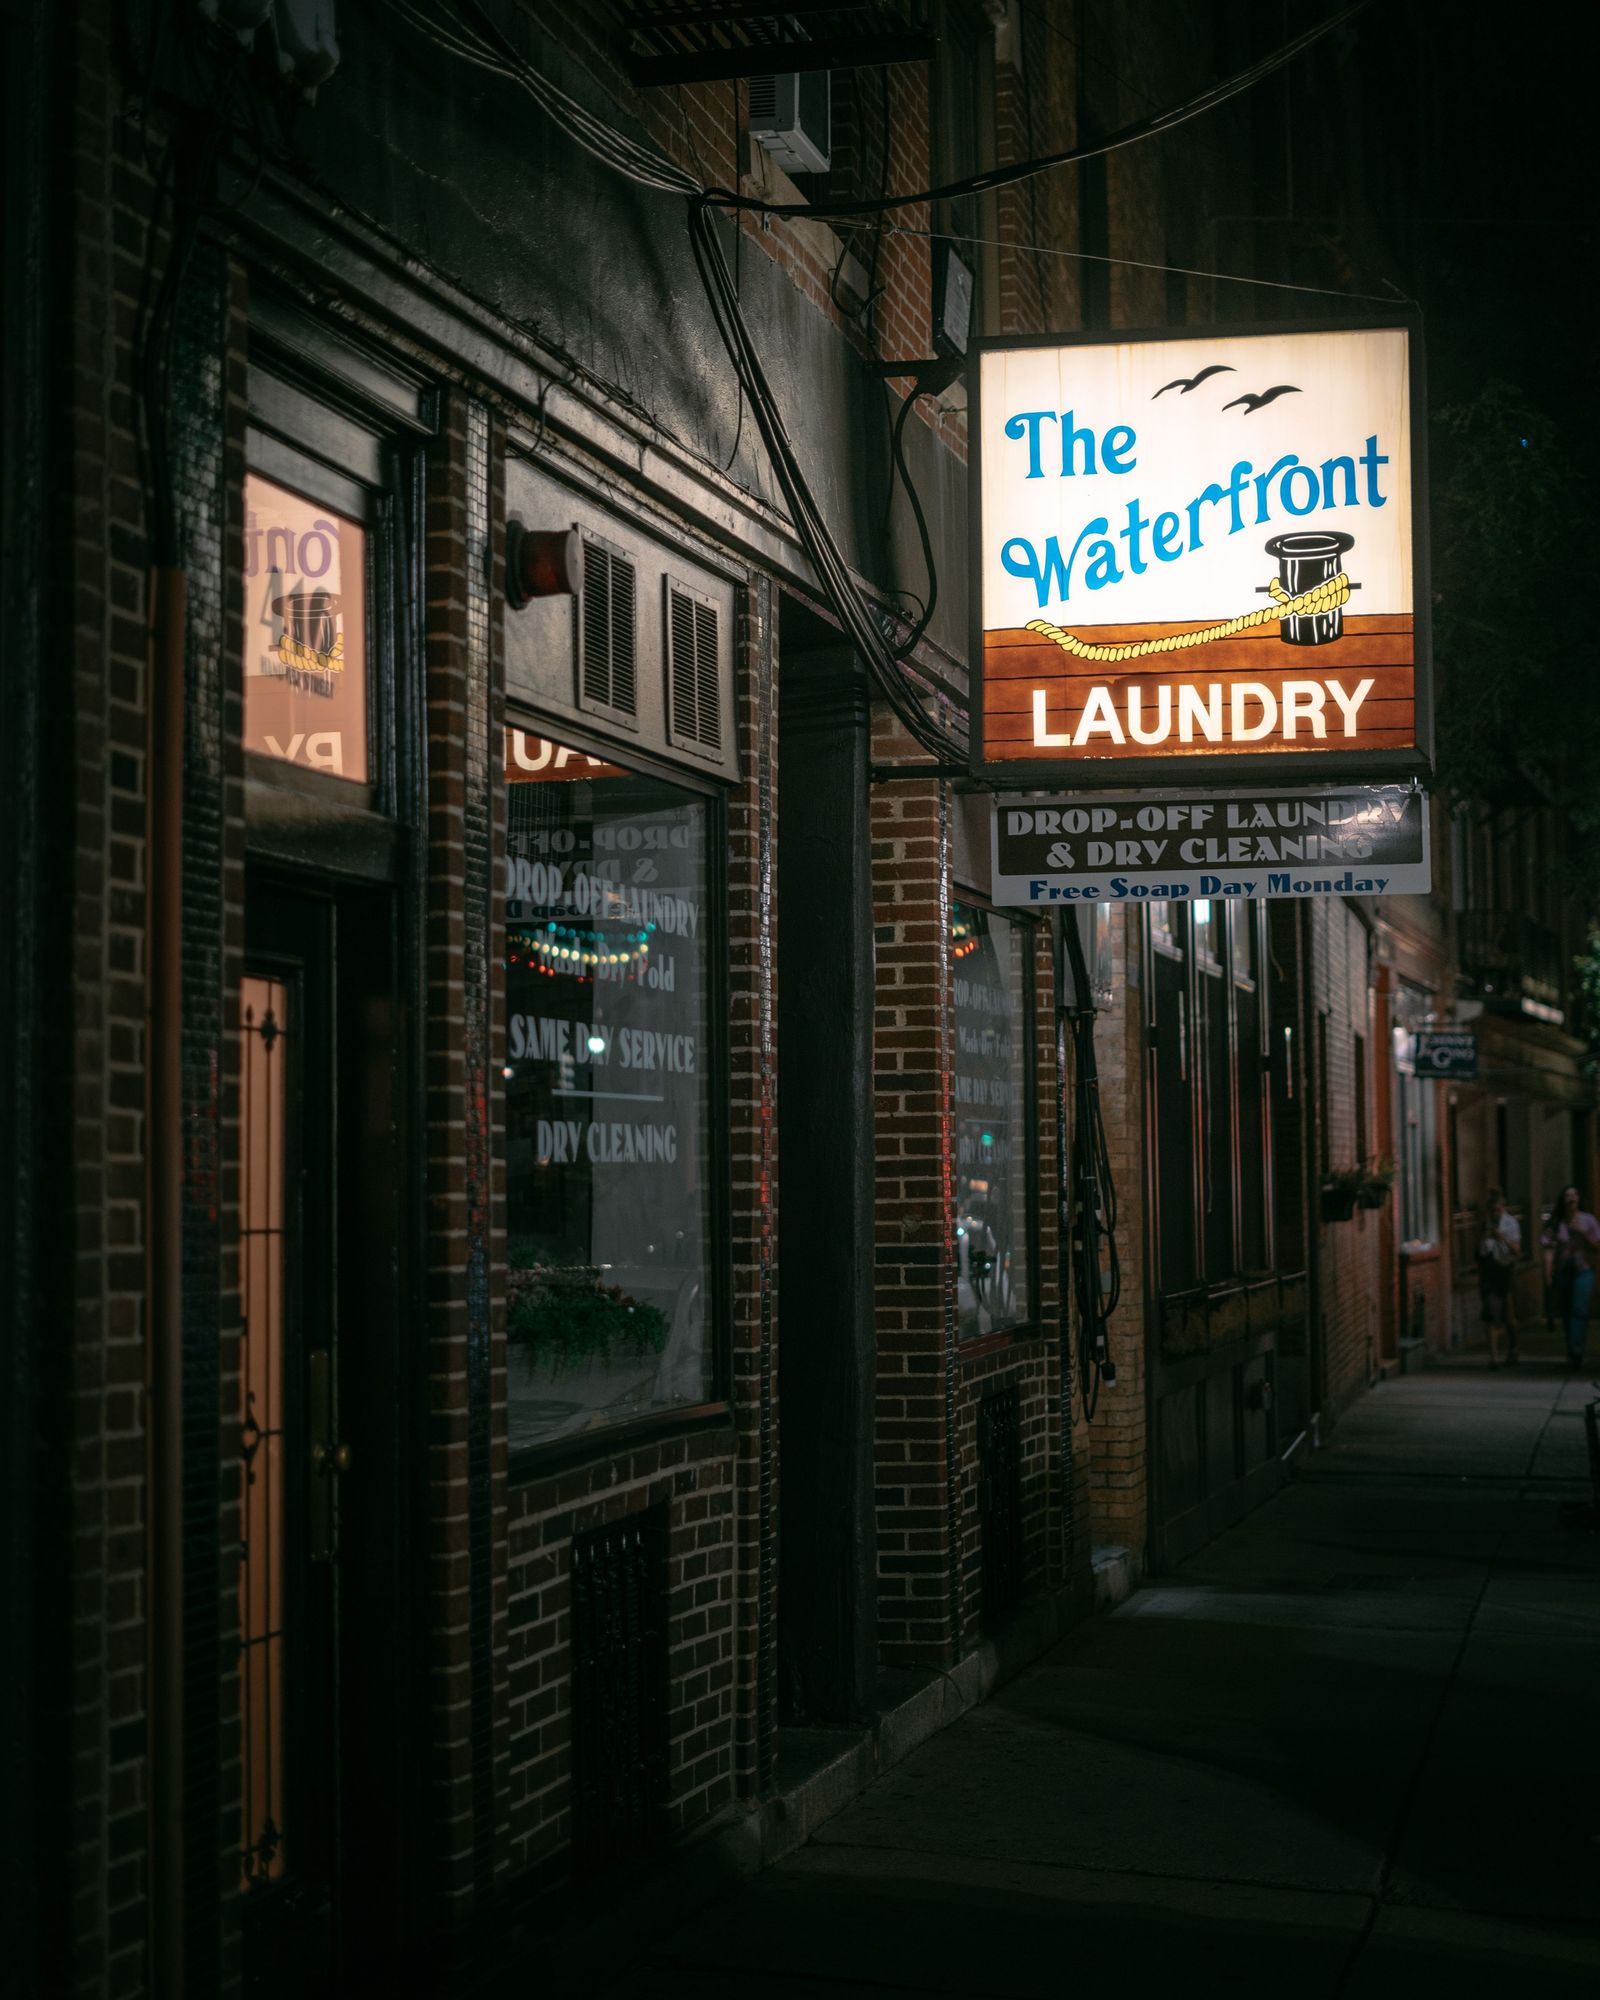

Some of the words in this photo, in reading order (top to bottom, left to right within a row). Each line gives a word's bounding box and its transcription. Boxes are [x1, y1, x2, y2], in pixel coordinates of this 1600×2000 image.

[1004, 409, 1137, 478] The
[1001, 435, 1389, 608] Waterfront
[1032, 679, 1375, 748] LAUNDRY
[1007, 805, 1214, 836] DROP-OFF
[1227, 798, 1410, 829] LAUNDRY
[1046, 842, 1075, 868] &
[1087, 839, 1168, 867] DRY
[1180, 833, 1373, 863] CLEANING
[504, 853, 616, 920] DROP-OFF
[618, 883, 699, 939] LAUNDRY
[1030, 880, 1100, 900] Free
[1109, 877, 1190, 899] Soap
[1200, 875, 1257, 897] Day
[1268, 872, 1390, 894] Monday
[510, 1013, 571, 1062] SAME
[576, 1021, 615, 1066] DAY
[619, 1026, 696, 1074] SERVICE
[537, 1119, 583, 1164] DRY
[586, 1121, 677, 1164] CLEANING
